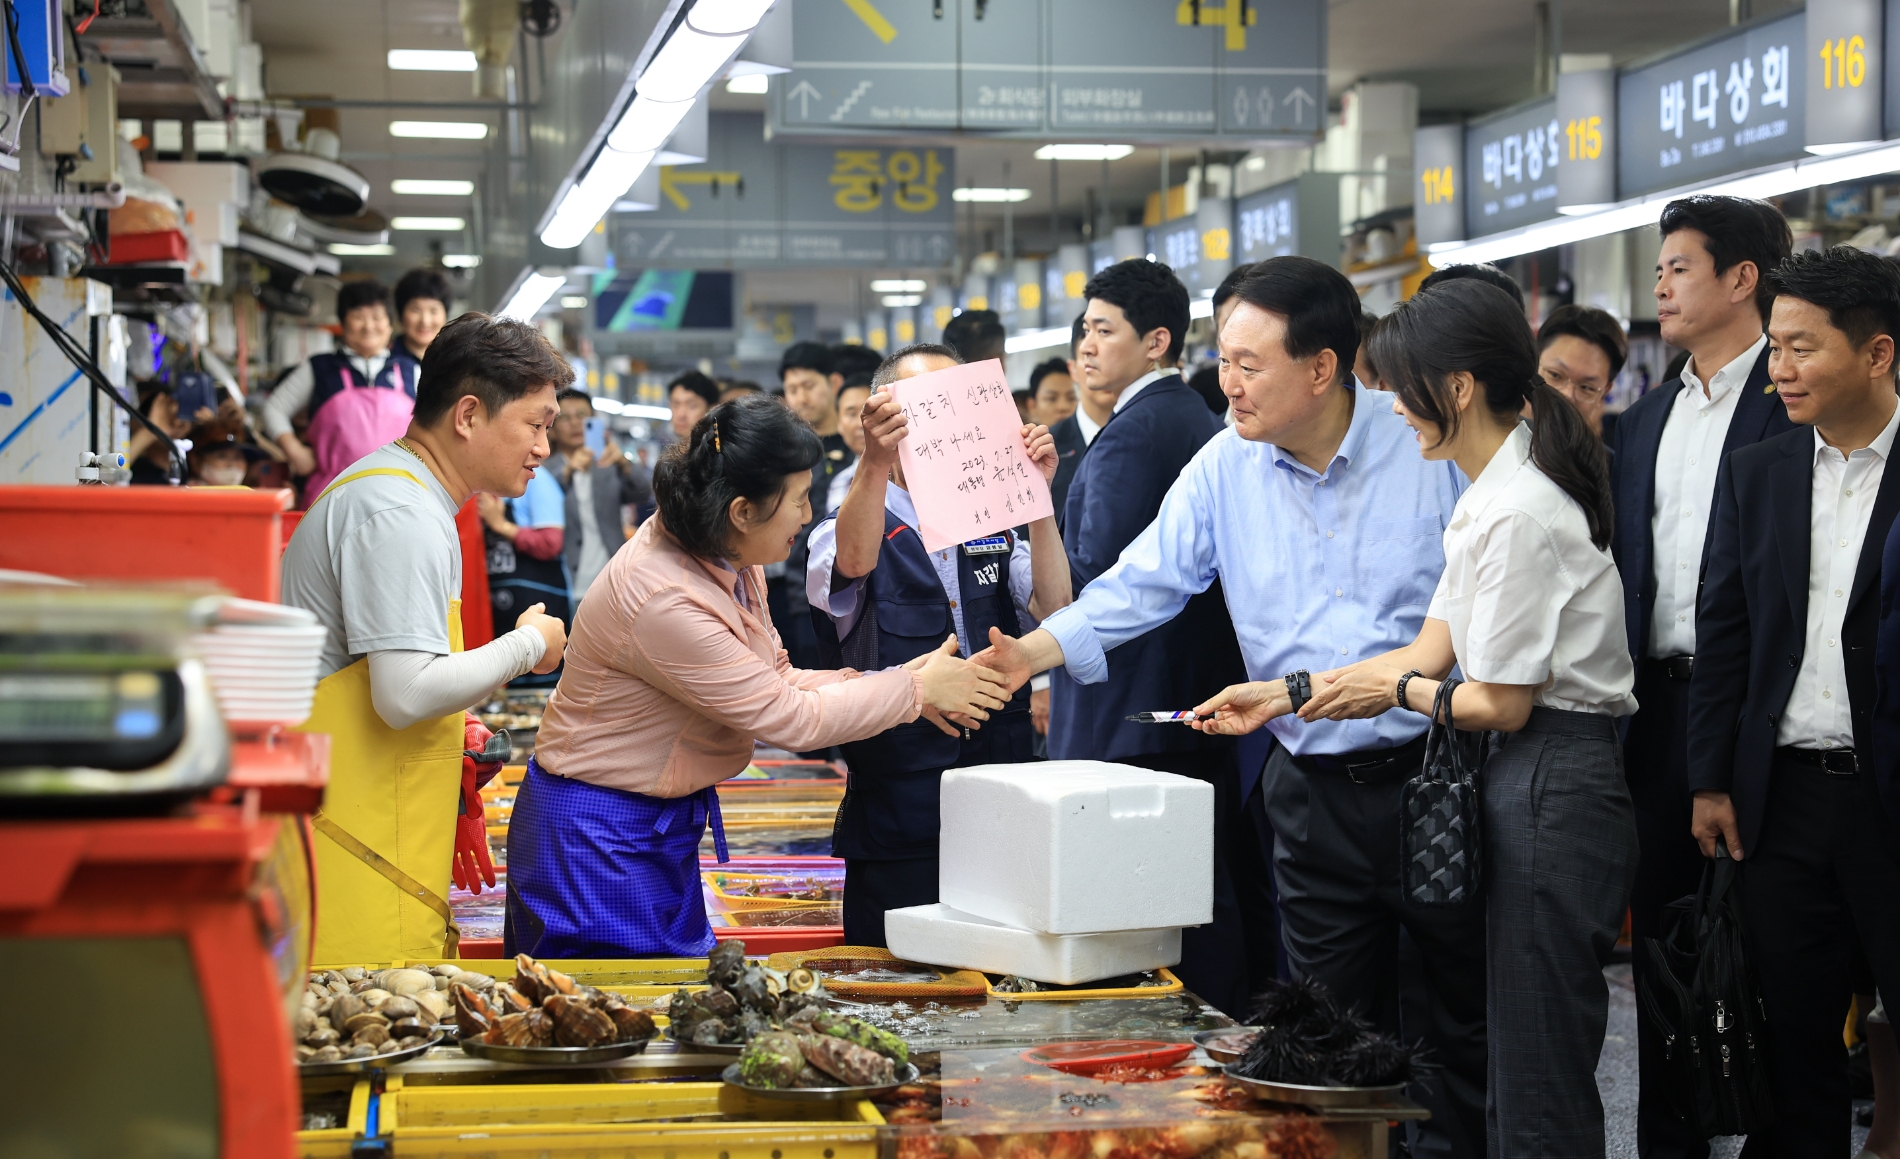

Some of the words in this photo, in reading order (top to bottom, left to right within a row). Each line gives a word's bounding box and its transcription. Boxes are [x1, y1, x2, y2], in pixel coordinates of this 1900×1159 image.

[1819, 34, 1866, 90] 116
[1660, 45, 1789, 139] 바다상회
[1565, 116, 1602, 161] 115
[828, 149, 945, 213] 중앙
[1421, 165, 1454, 205] 114
[902, 390, 957, 428] 자갈치
[915, 438, 945, 461] 대박
[949, 425, 987, 452] 나세요
[957, 474, 986, 494] 대통령
